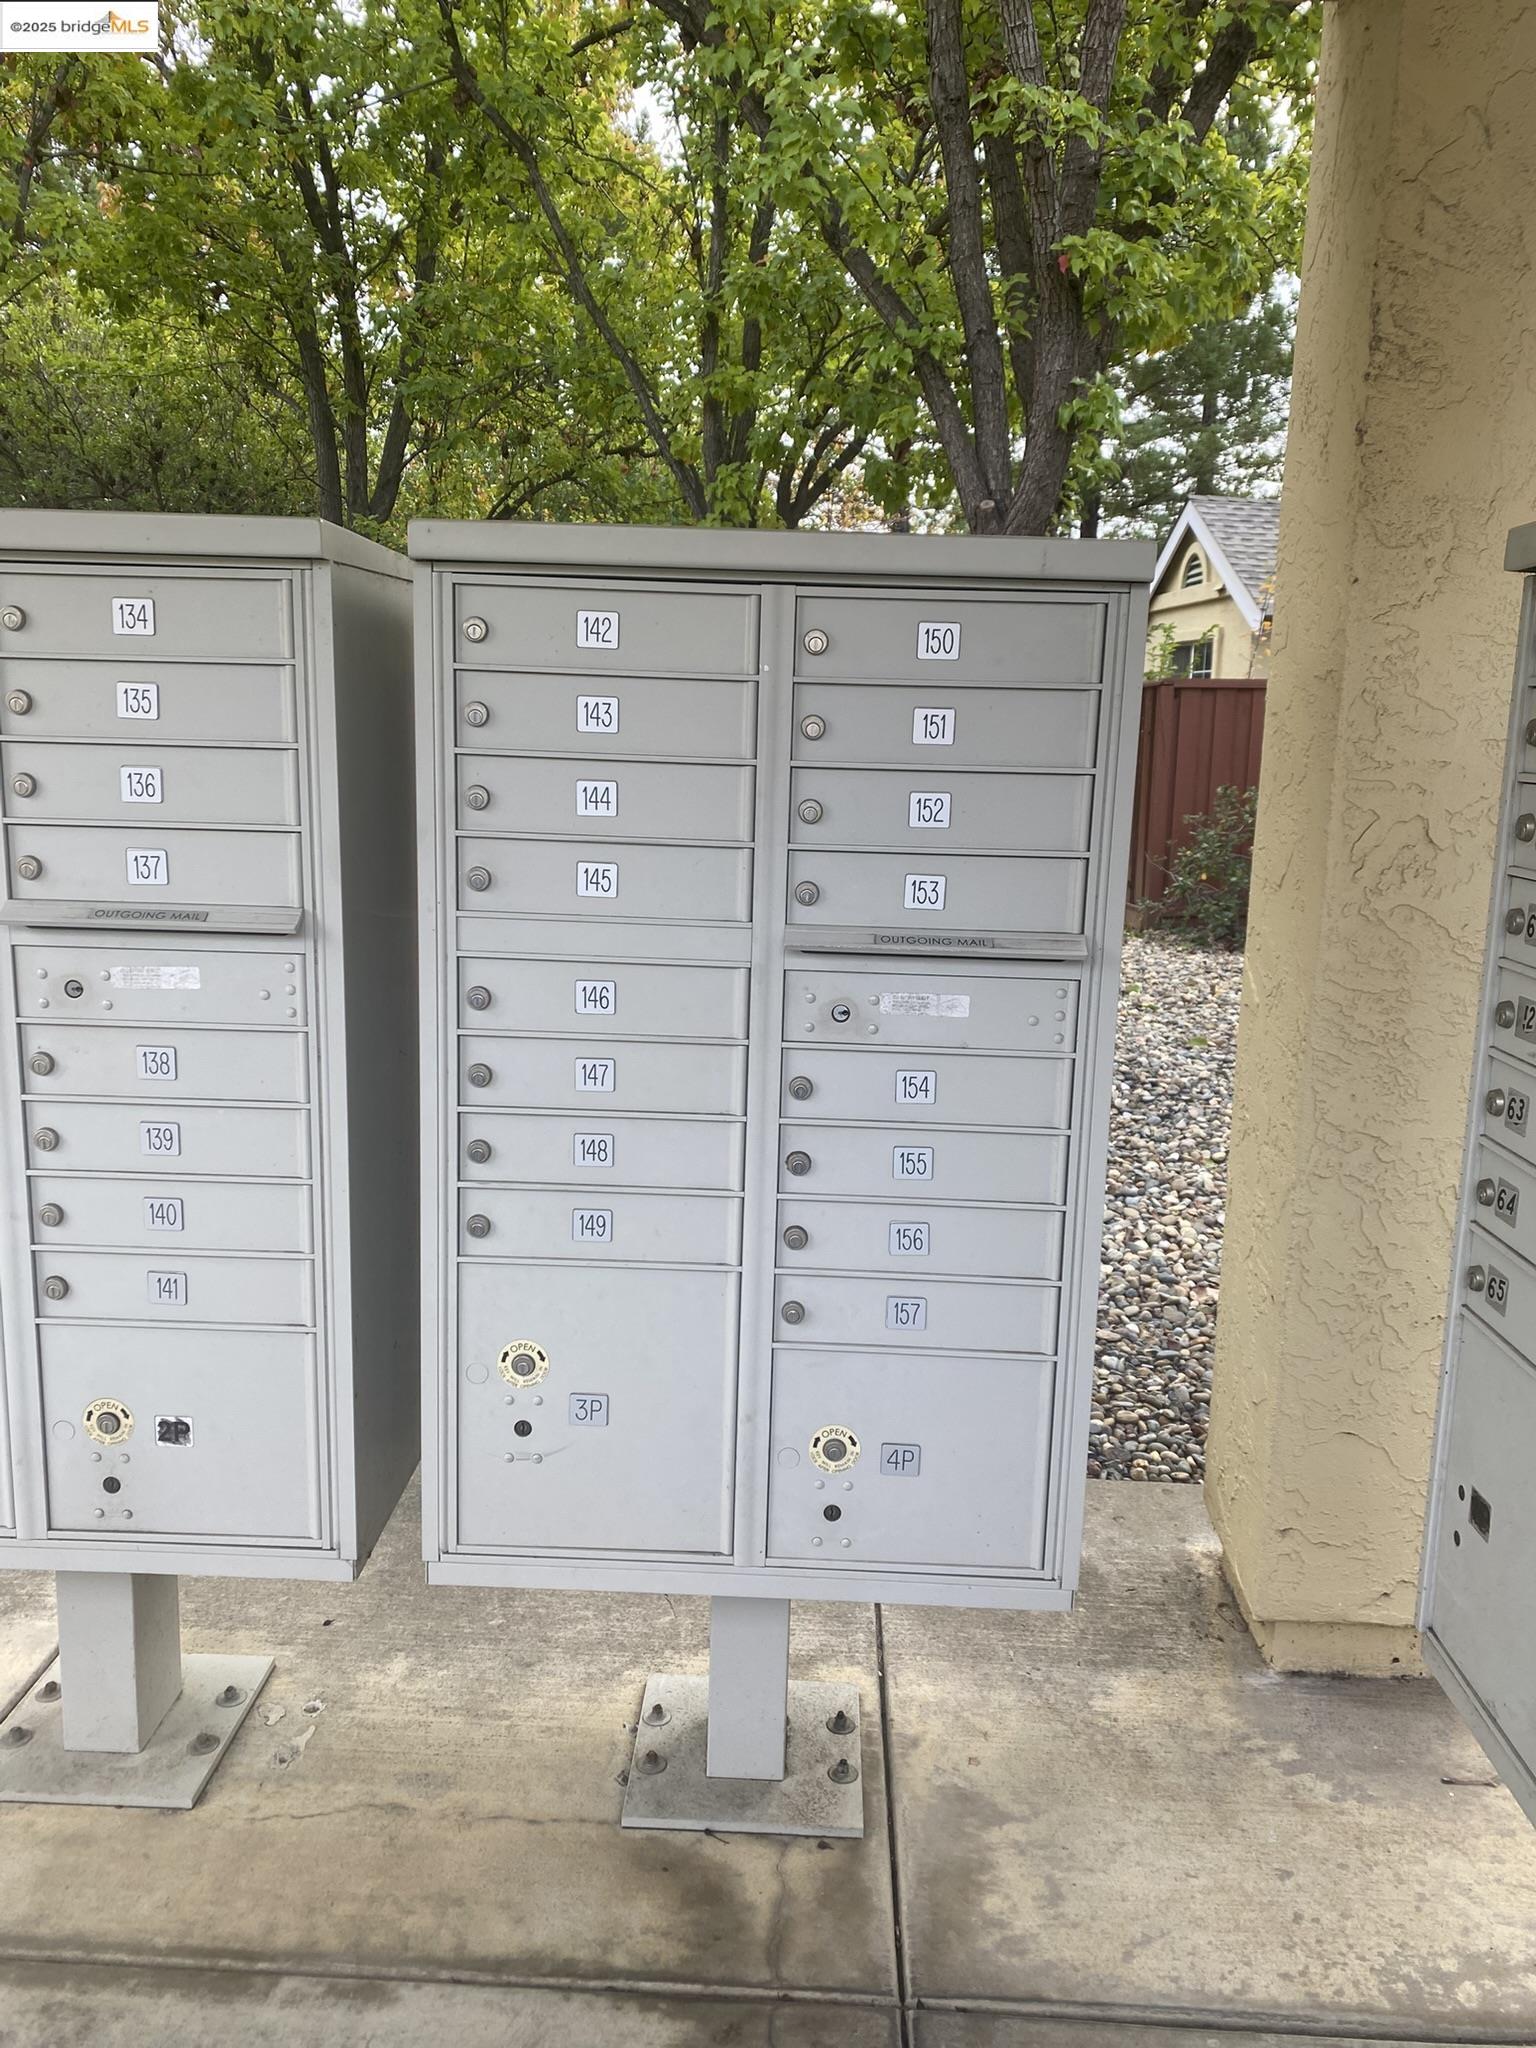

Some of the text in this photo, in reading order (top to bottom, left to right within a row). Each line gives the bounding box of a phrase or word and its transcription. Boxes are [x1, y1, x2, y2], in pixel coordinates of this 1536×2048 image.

[119, 604, 148, 629] 134
[584, 617, 612, 643] 142
[925, 628, 954, 654] 150
[124, 688, 151, 713] 135
[584, 702, 612, 727] 143
[923, 714, 945, 739] 151
[128, 773, 155, 797] 136
[583, 786, 611, 810] 144
[917, 798, 943, 822] 152
[134, 856, 160, 879] 137
[584, 868, 611, 892] 145
[912, 880, 938, 904] 153
[94, 909, 200, 921] OUTGOING MAIL
[880, 935, 987, 947] OUTGOING MAIL
[582, 986, 609, 1009] 146
[143, 1052, 170, 1075] 138
[582, 1064, 608, 1086] 147
[902, 1076, 929, 1099] 154
[1507, 1097, 1526, 1121] 63
[146, 1128, 173, 1150] 139
[581, 1139, 607, 1162] 148
[900, 1152, 926, 1175] 155
[150, 1203, 176, 1225] 140
[1497, 1189, 1517, 1216] 64
[580, 1215, 606, 1237] 149
[896, 1228, 923, 1250] 156
[157, 1278, 177, 1299] 141
[1487, 1277, 1507, 1302] 65
[895, 1302, 920, 1325] 157
[510, 1343, 537, 1353] OPEN
[93, 1401, 119, 1412] OPEN
[576, 1399, 602, 1420] 3P
[821, 1428, 848, 1438] OPEN
[887, 1450, 914, 1470] 4P
